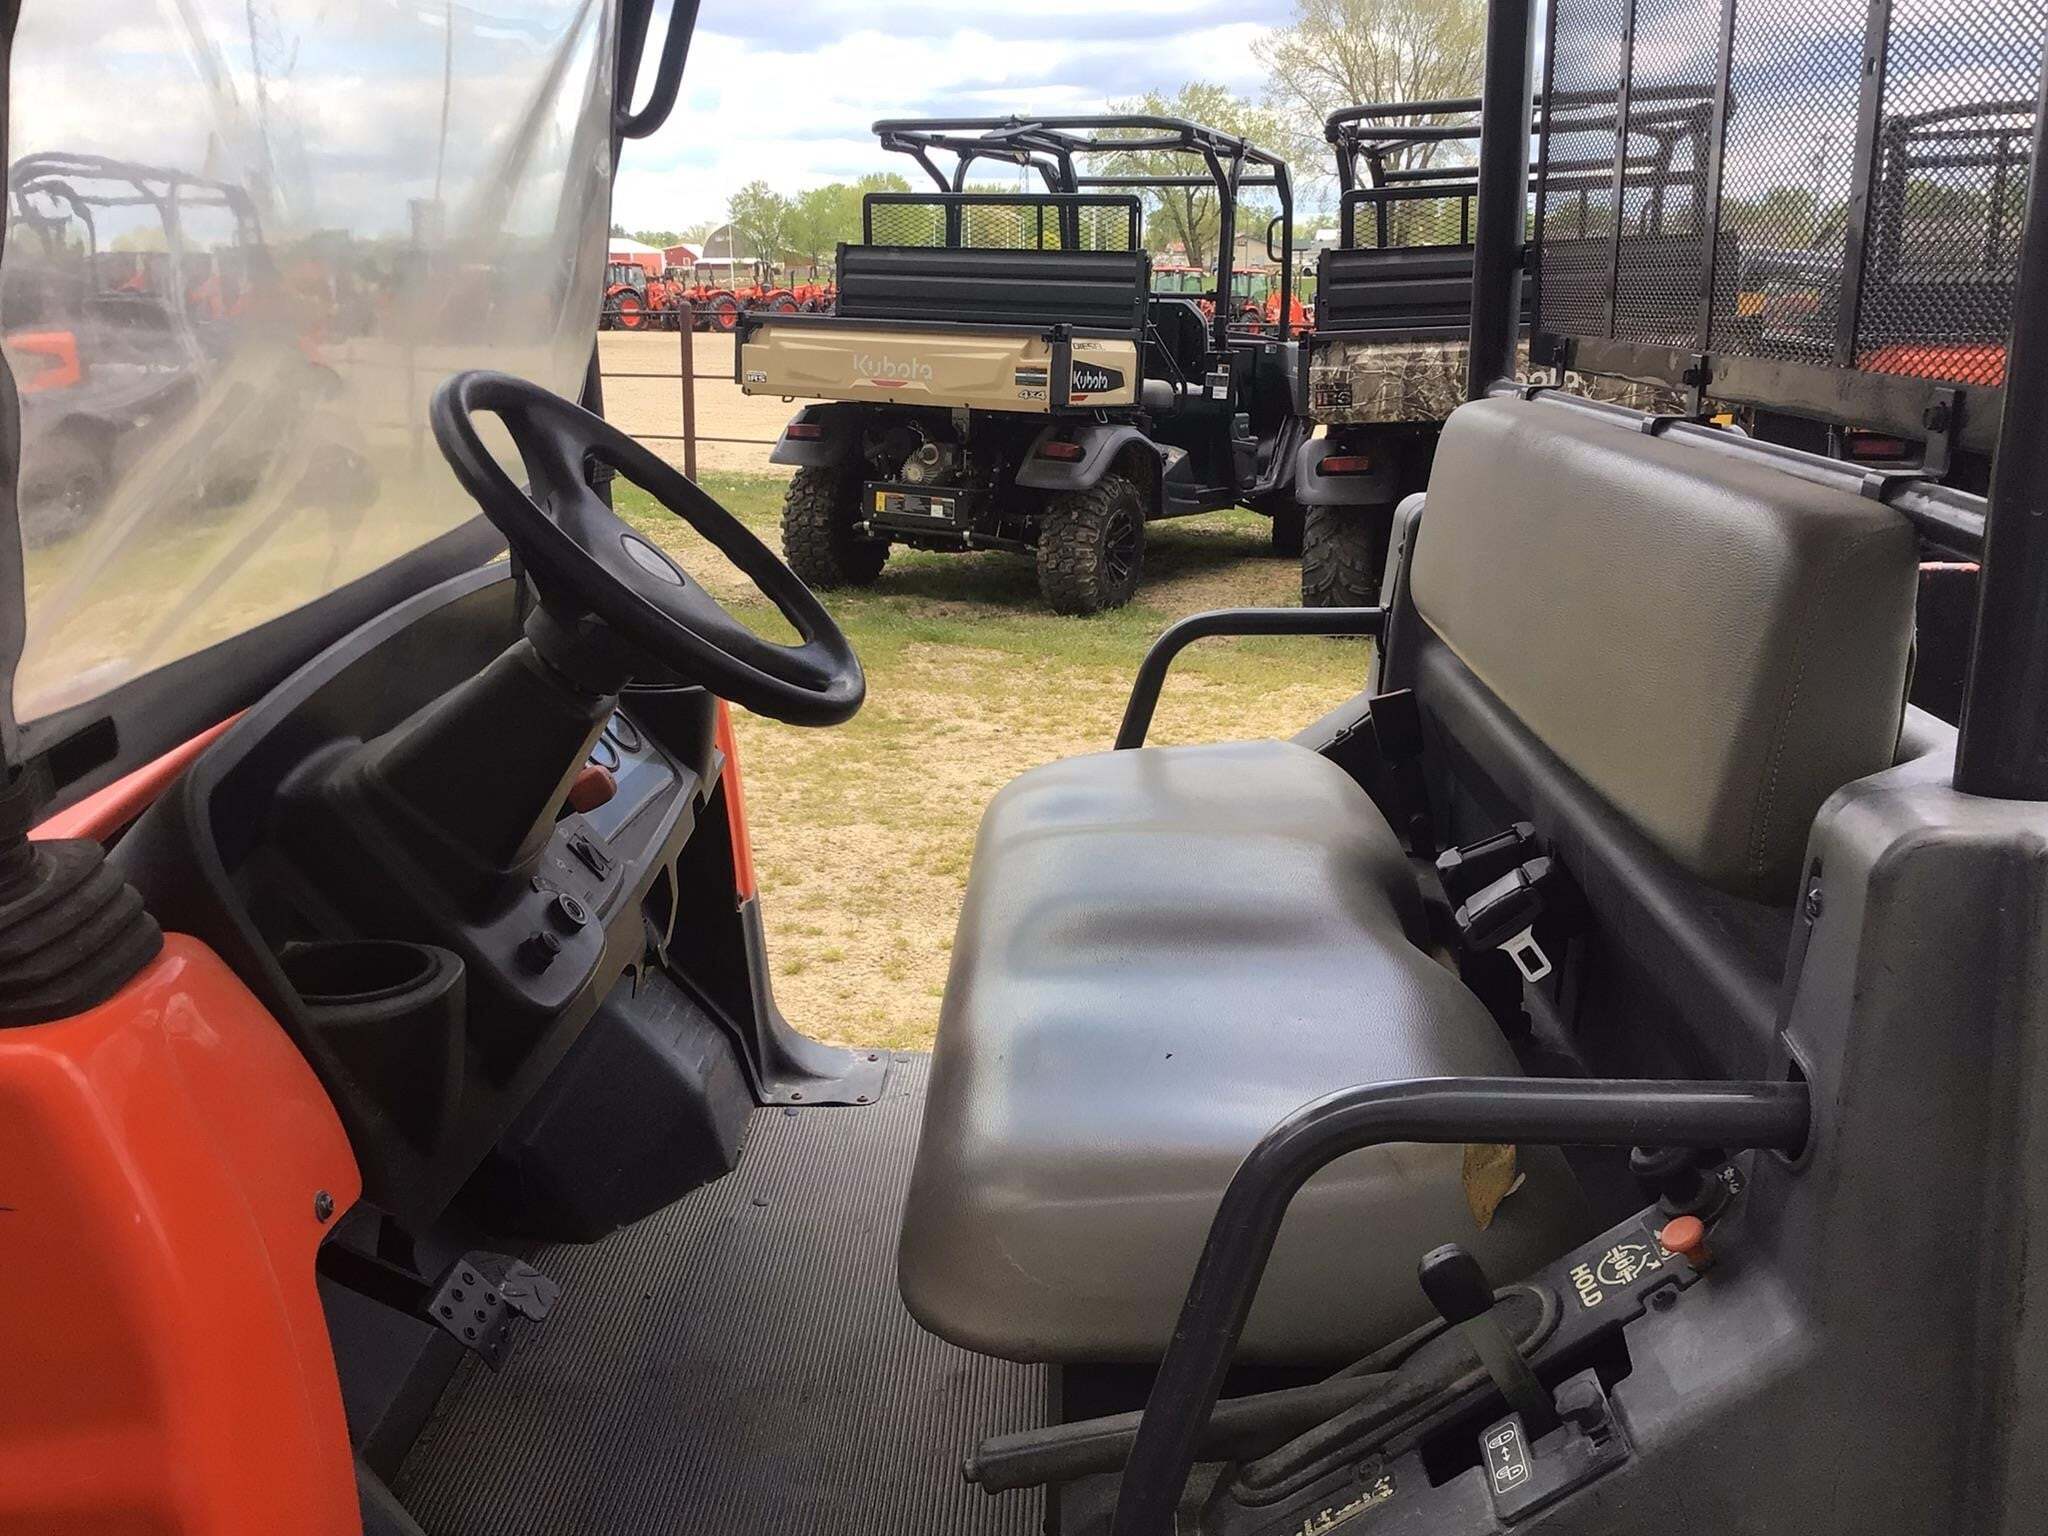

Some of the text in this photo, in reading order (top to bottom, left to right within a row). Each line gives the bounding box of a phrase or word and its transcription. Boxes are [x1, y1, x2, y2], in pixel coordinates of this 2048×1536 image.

[853, 354, 933, 379] Kubota
[1073, 370, 1108, 389] Kubota
[1570, 1263, 1603, 1308] HOLD
